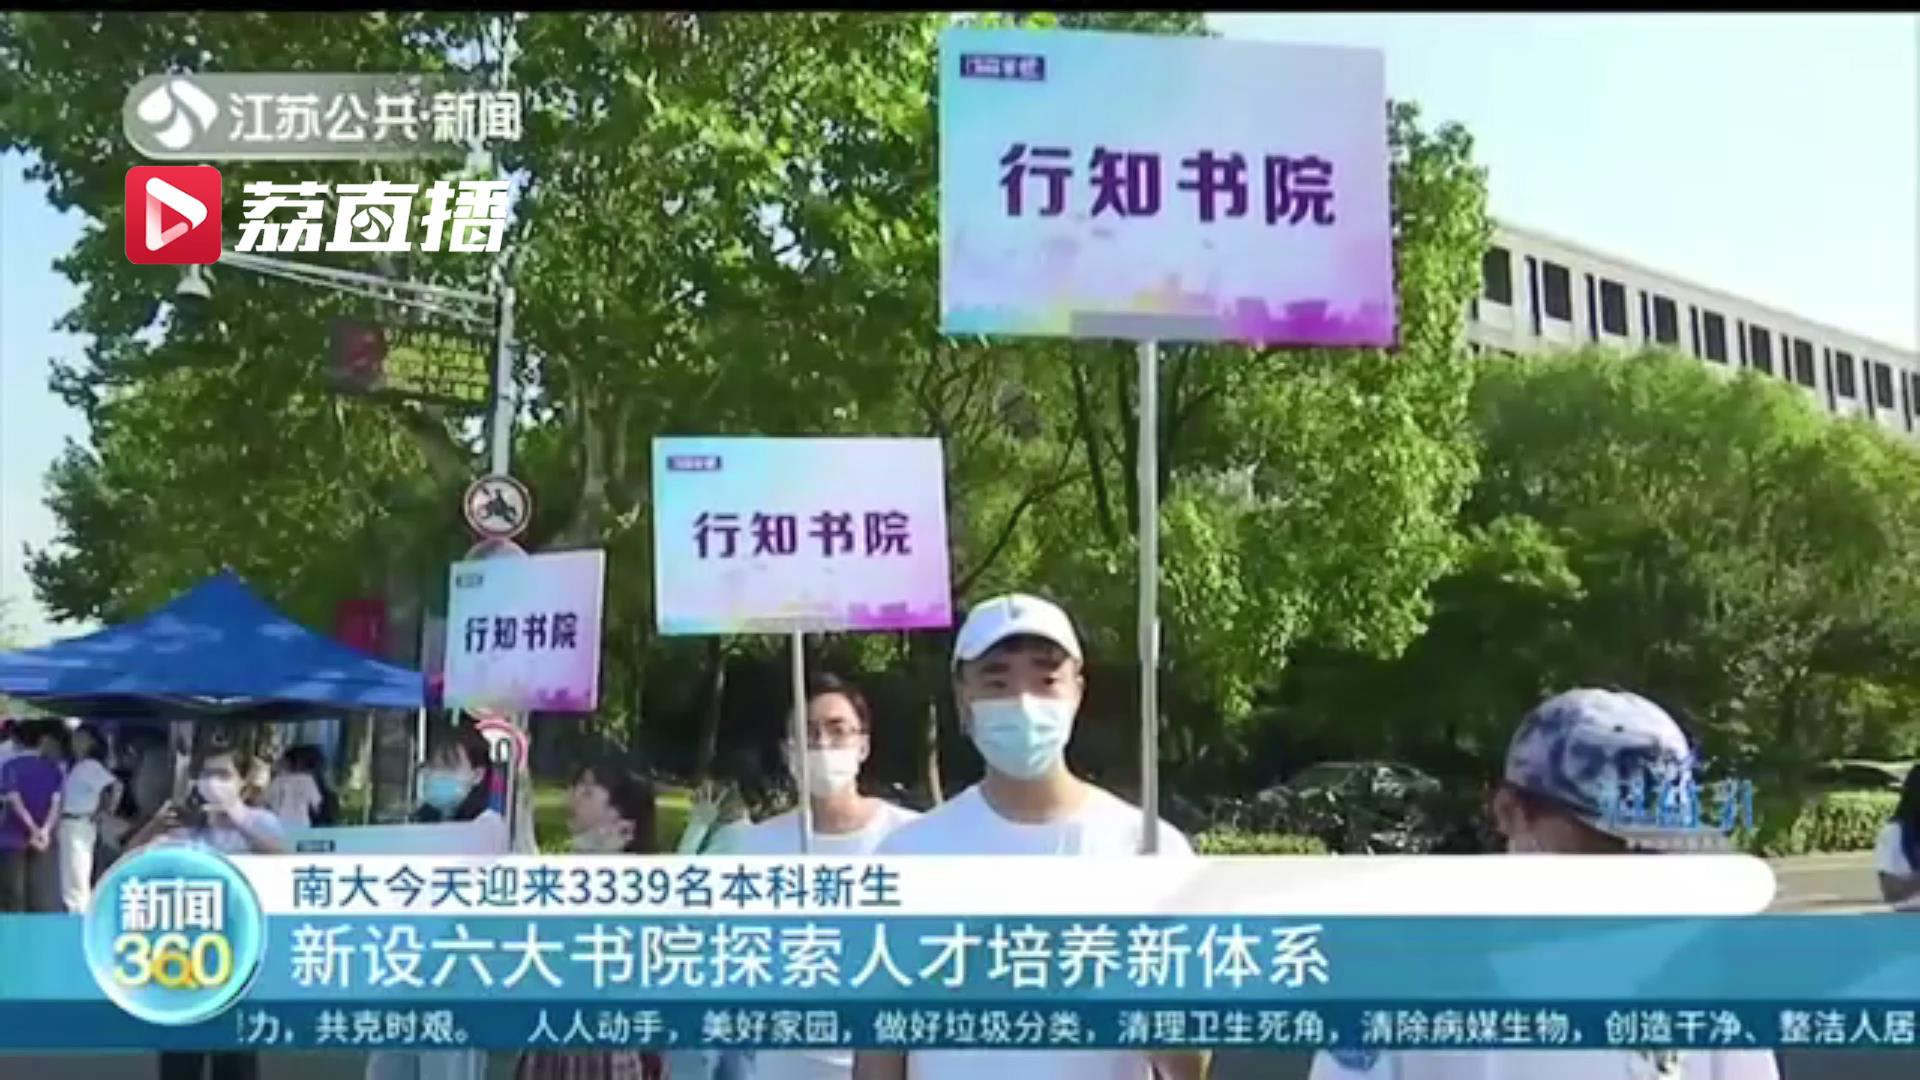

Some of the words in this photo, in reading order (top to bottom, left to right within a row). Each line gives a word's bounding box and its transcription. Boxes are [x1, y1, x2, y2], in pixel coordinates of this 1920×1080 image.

[1000, 143, 1336, 226] 行知书院
[693, 511, 912, 559] 行知书院
[465, 612, 577, 652] 行知书院
